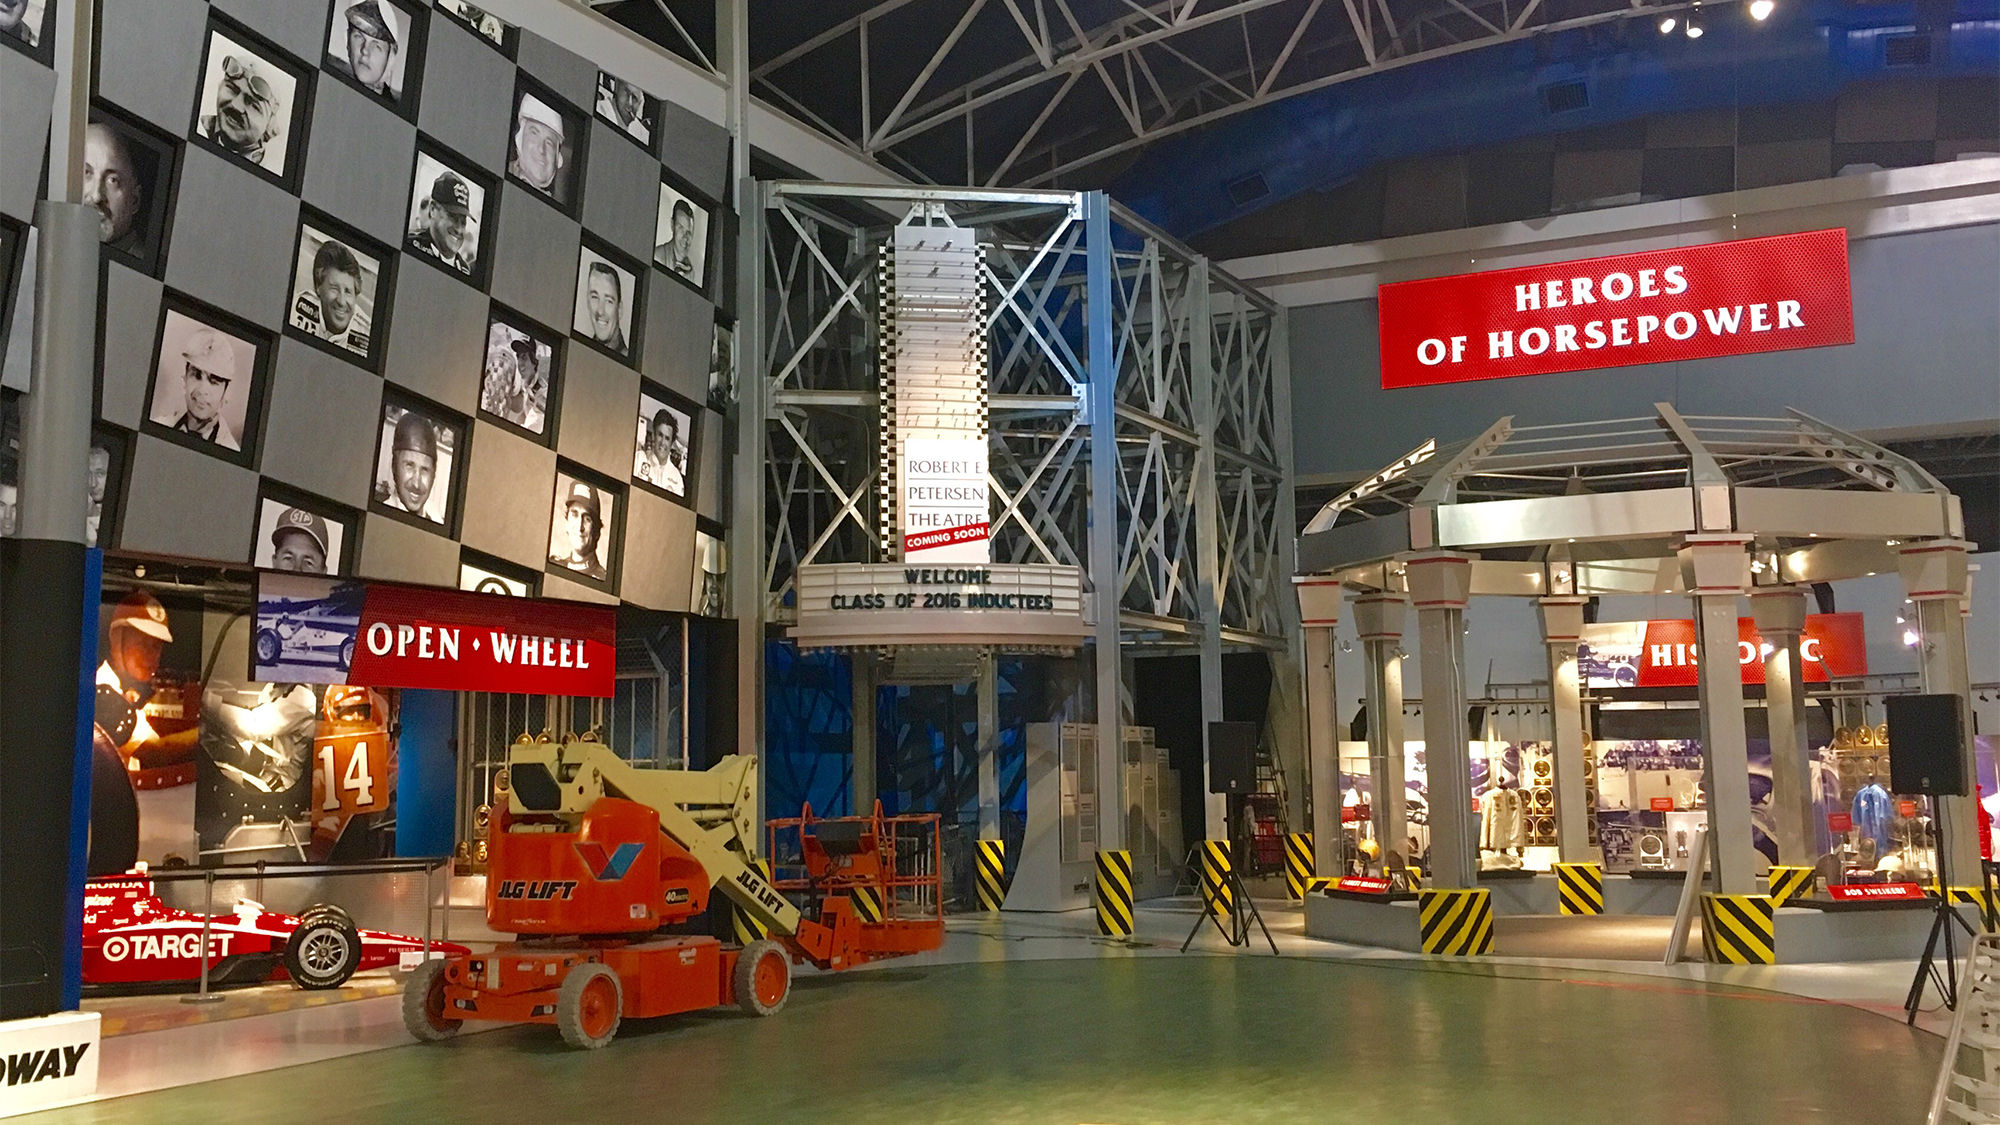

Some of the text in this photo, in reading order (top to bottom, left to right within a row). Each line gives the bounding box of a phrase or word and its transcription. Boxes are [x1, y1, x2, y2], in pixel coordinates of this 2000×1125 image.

[1515, 265, 1689, 311] HEROES
[1416, 300, 1806, 366] OF HORSEPOWER
[909, 460, 969, 474] ROBERT
[908, 486, 984, 501] PETERSEN
[908, 513, 983, 527] THEATRE
[907, 526, 985, 548] COMING SOON
[903, 568, 992, 585] WELCOME
[830, 592, 1053, 610] CLASS OF 2016 INDUCTEES
[366, 621, 590, 669] OPEN WHEEL
[317, 741, 375, 811] 14
[497, 880, 579, 900] JLG LIFT
[735, 869, 785, 914] JLG LIFT
[129, 932, 235, 960] TARGET
